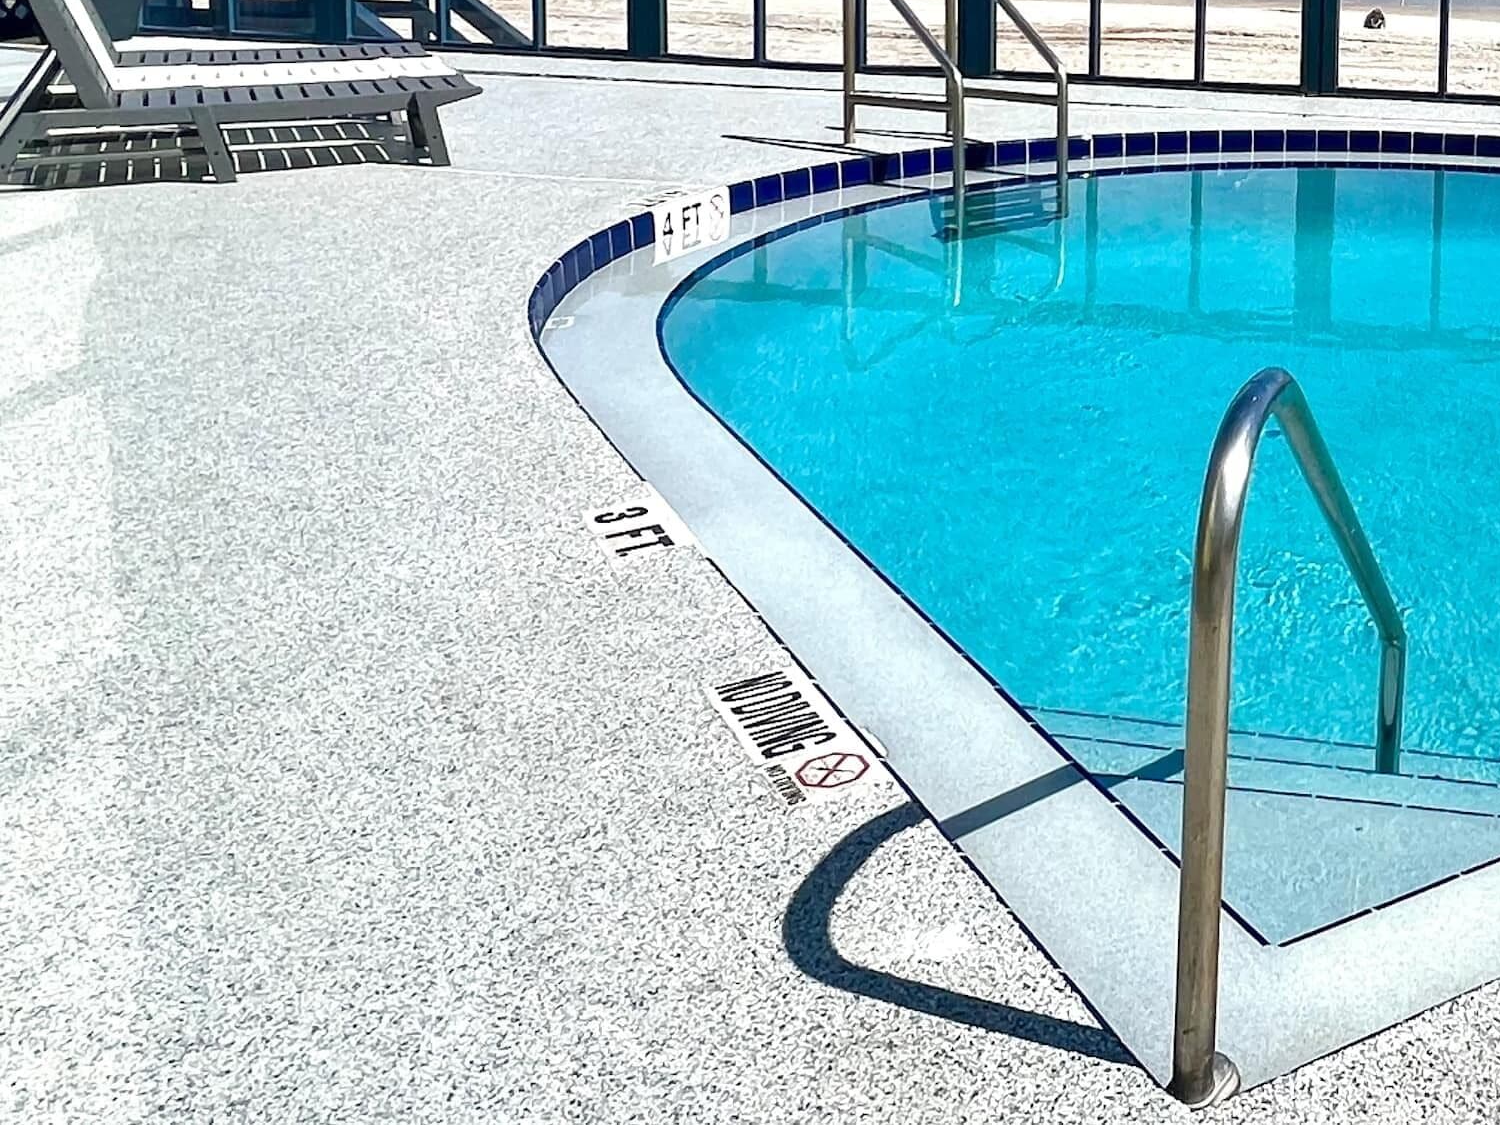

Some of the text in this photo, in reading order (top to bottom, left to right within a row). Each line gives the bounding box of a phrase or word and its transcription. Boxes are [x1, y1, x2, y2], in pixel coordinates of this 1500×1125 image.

[662, 203, 702, 236] 4 FT
[594, 507, 648, 523] 3
[714, 671, 837, 759] NO DIVING
